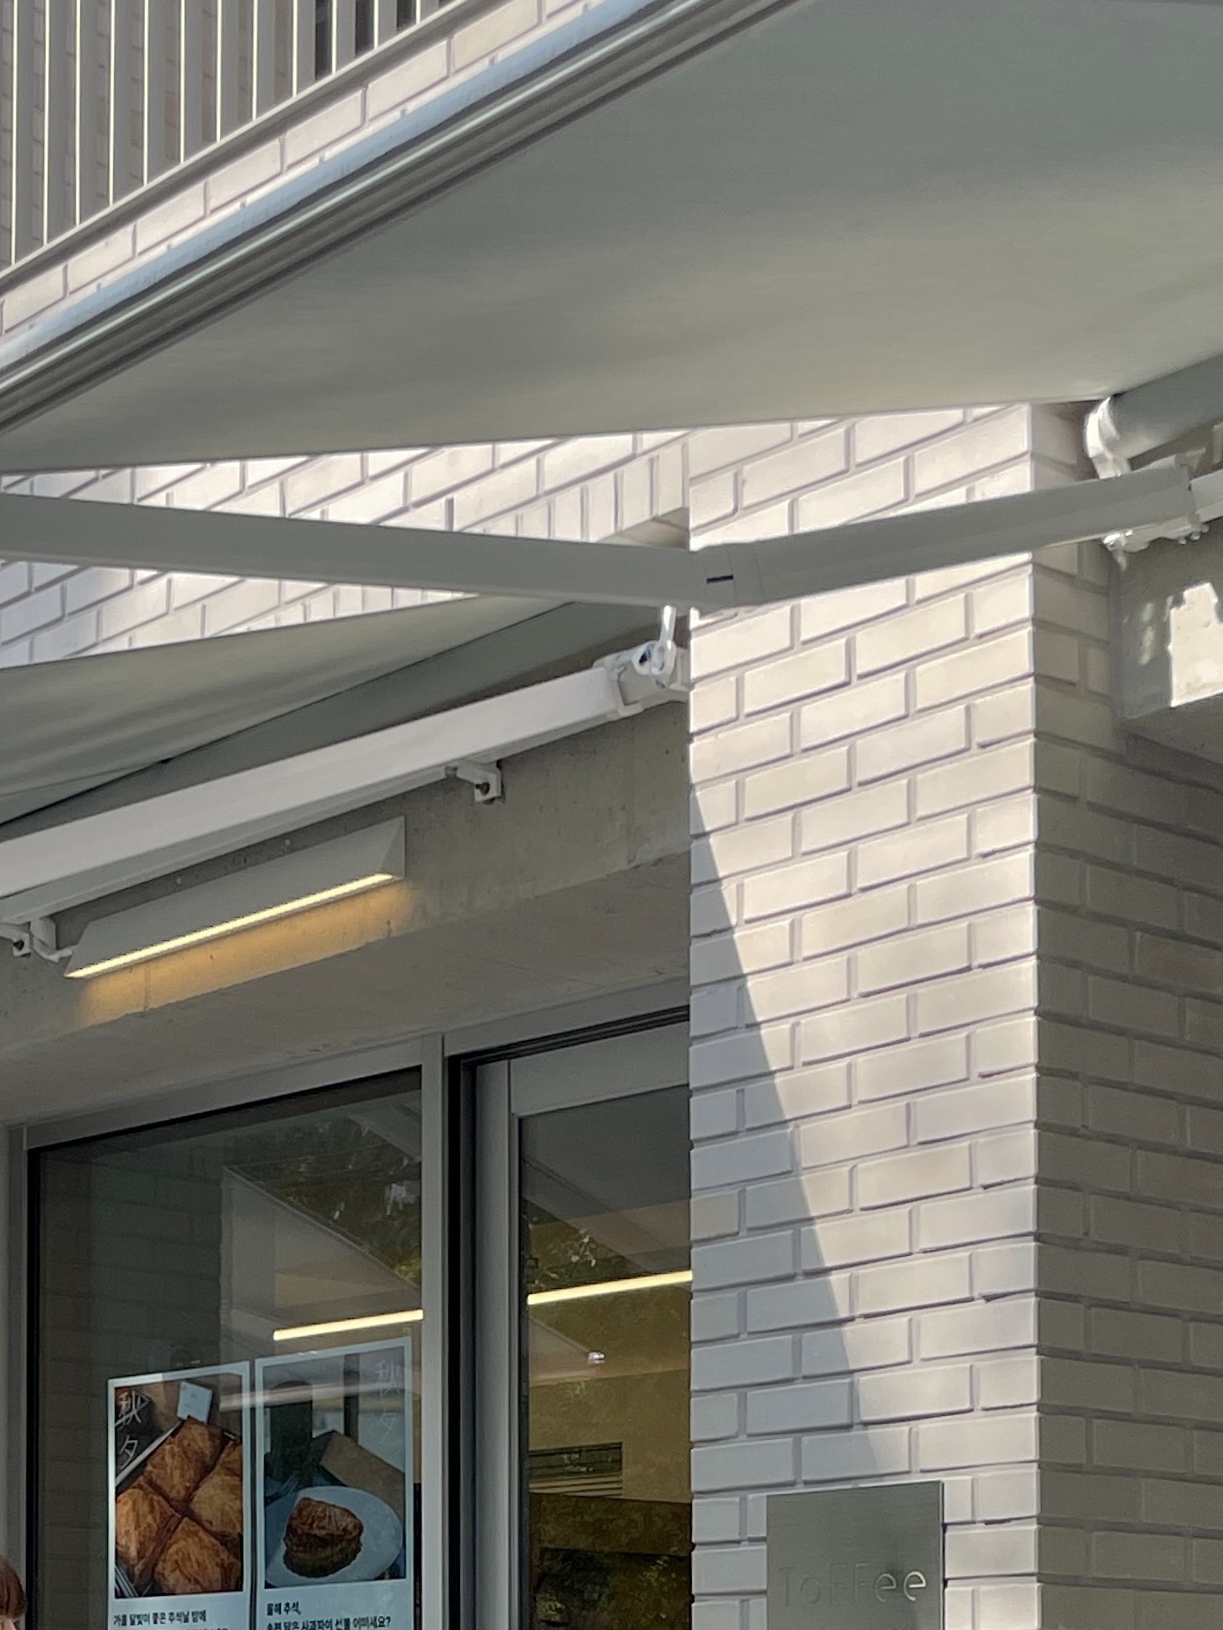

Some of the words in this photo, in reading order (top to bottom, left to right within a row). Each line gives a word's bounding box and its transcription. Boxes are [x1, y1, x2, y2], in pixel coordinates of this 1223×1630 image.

[284, 1600, 302, 1616] 추석,
[168, 1610, 190, 1624] 추석날
[352, 1615, 392, 1630] 어떠세요?
